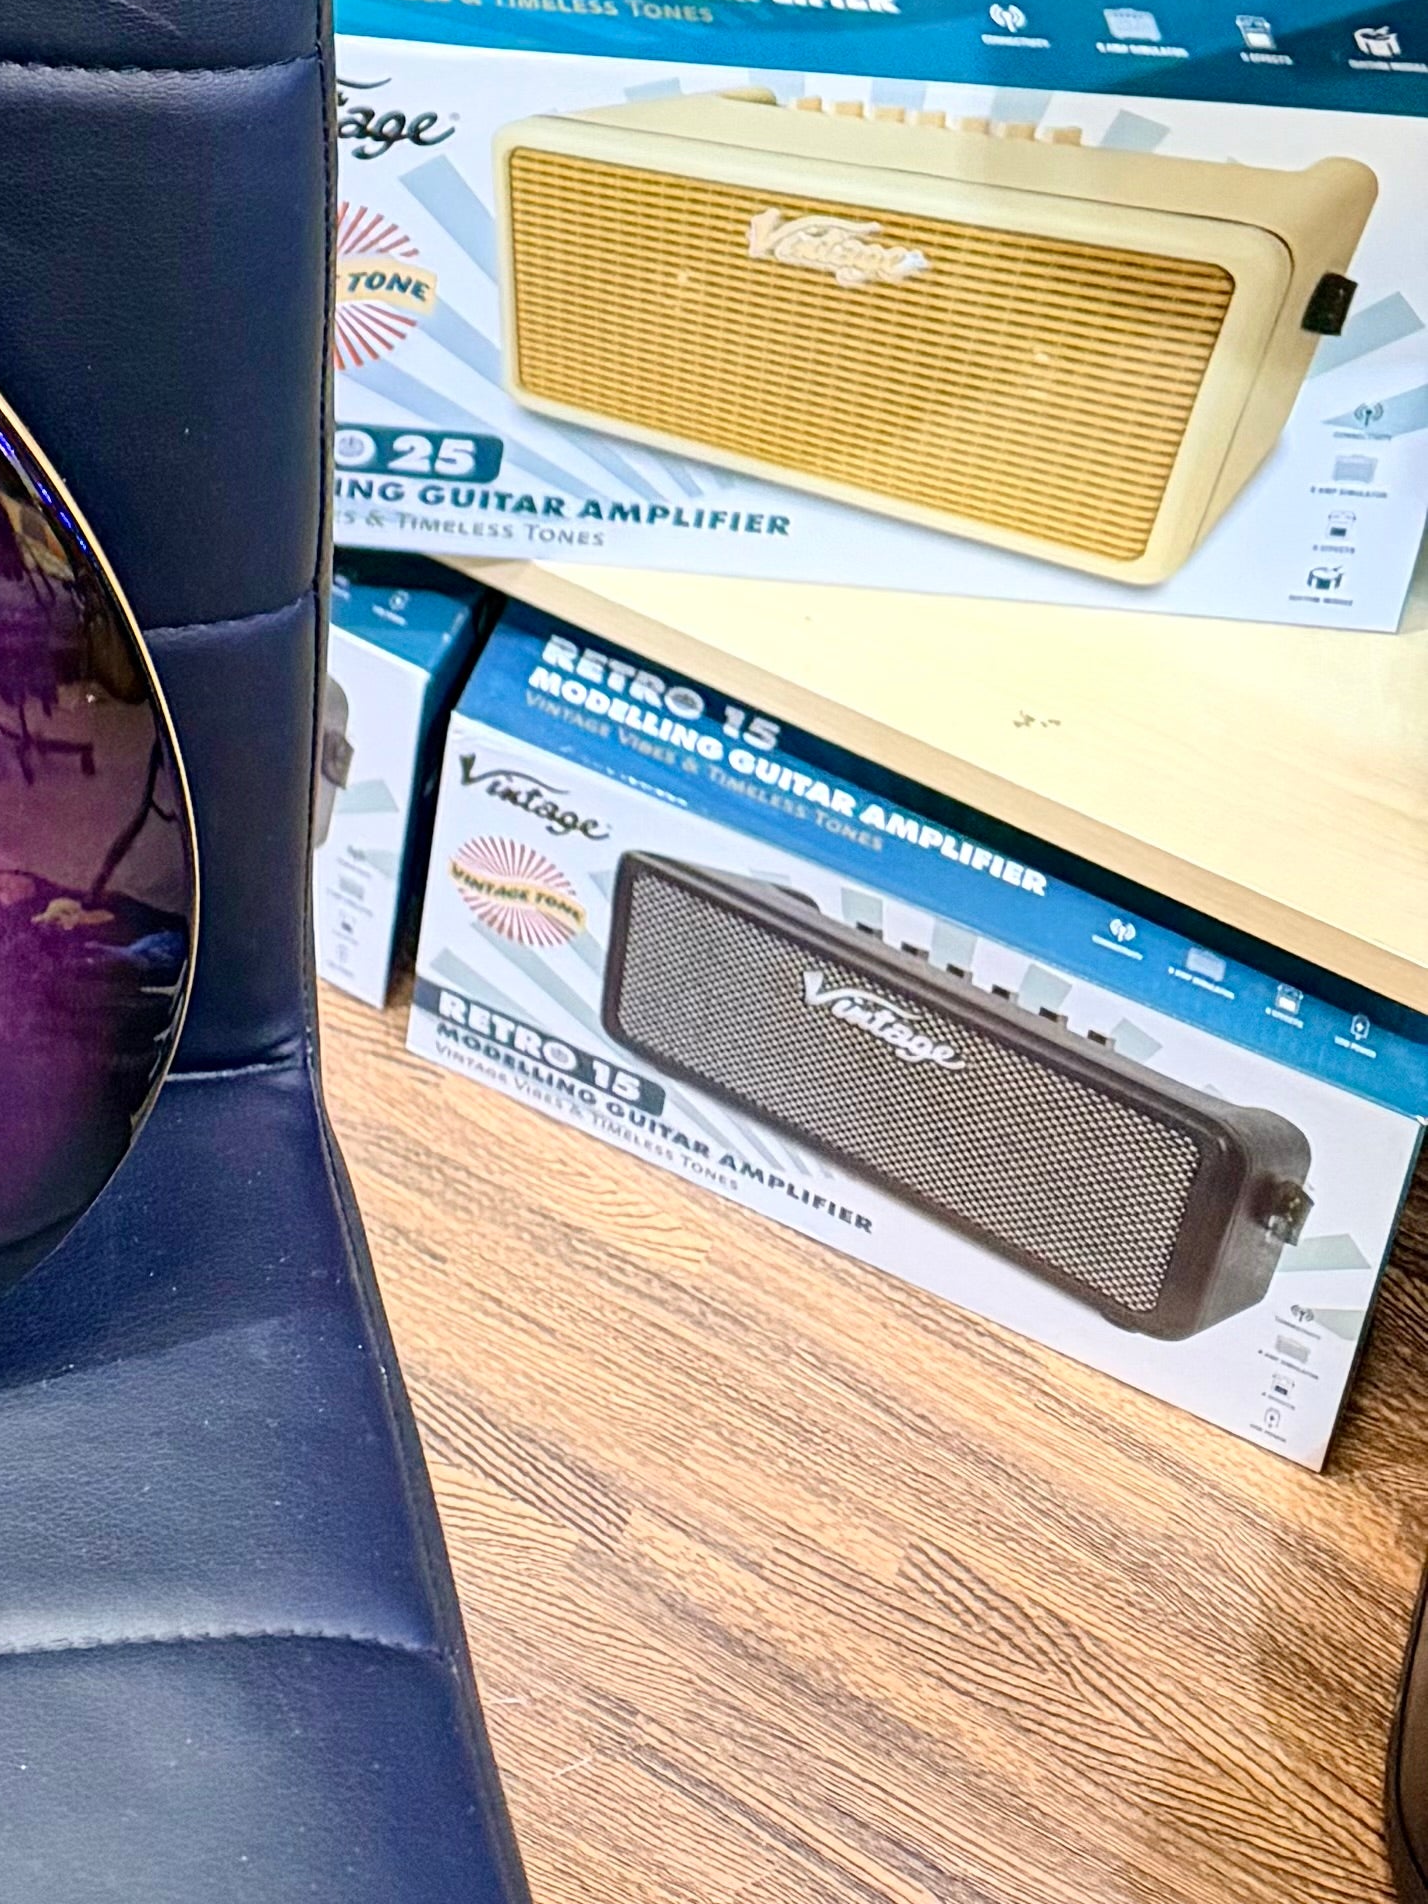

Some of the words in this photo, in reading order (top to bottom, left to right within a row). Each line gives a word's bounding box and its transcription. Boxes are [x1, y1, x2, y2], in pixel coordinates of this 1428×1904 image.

[347, 272, 431, 302] TONE
[746, 207, 930, 288] Vintage
[388, 435, 477, 476] 25
[418, 483, 567, 518] GUITAR
[578, 499, 791, 536] AMPLIFIER
[542, 633, 704, 721] RETRO
[722, 704, 781, 753] 15
[459, 753, 611, 841] Vintage
[528, 665, 724, 762] MODELLING
[727, 746, 857, 819] GUITAR
[858, 805, 1048, 897] AMPLIFIER
[438, 993, 578, 1072] RETRO
[592, 1061, 641, 1103] 15
[803, 971, 965, 1070] Vintage
[437, 1022, 596, 1105] MODELLING
[605, 1098, 709, 1158] GUITAR
[719, 1153, 874, 1234] AMPLIFIER
